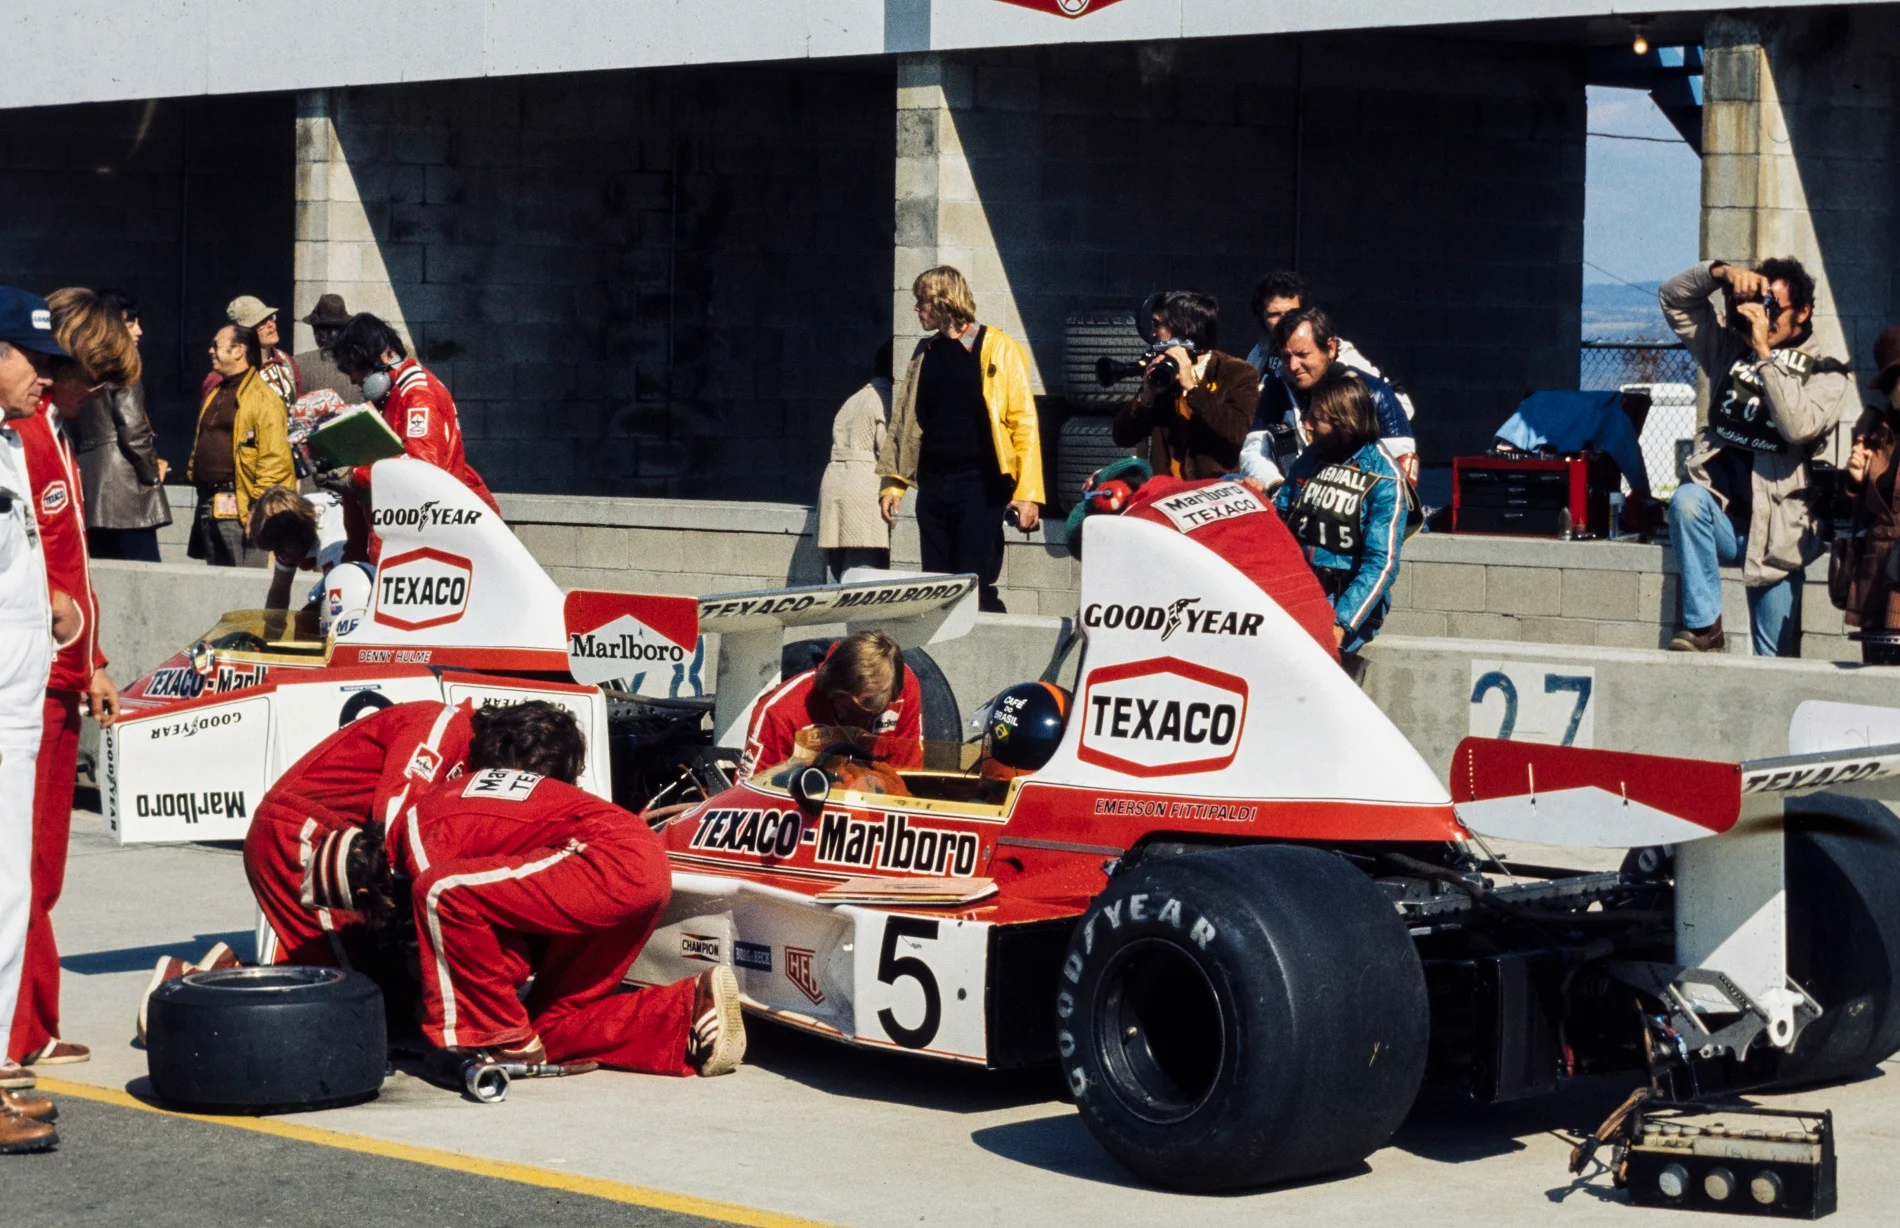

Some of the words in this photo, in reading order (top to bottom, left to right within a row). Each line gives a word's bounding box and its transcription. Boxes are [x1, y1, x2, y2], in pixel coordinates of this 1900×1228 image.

[1751, 438, 1777, 452] Glen
[1165, 485, 1244, 511] Marlboro
[1303, 482, 1359, 515] PHOTO
[1183, 499, 1257, 525] TEXACO
[383, 577, 466, 606] TEXACO
[359, 650, 394, 662] DENNY
[395, 651, 432, 663] HULME
[571, 634, 684, 661] Marlboro
[994, 710, 1018, 727] BRASIL
[1092, 695, 1236, 745] TEXACO
[1470, 671, 1592, 747] 27
[136, 790, 247, 824] Marlboro
[1094, 798, 1166, 818] EMERSON
[1170, 803, 1258, 822] FITTIPALDI
[682, 939, 719, 956] CHAMPION
[877, 915, 942, 1050] 5
